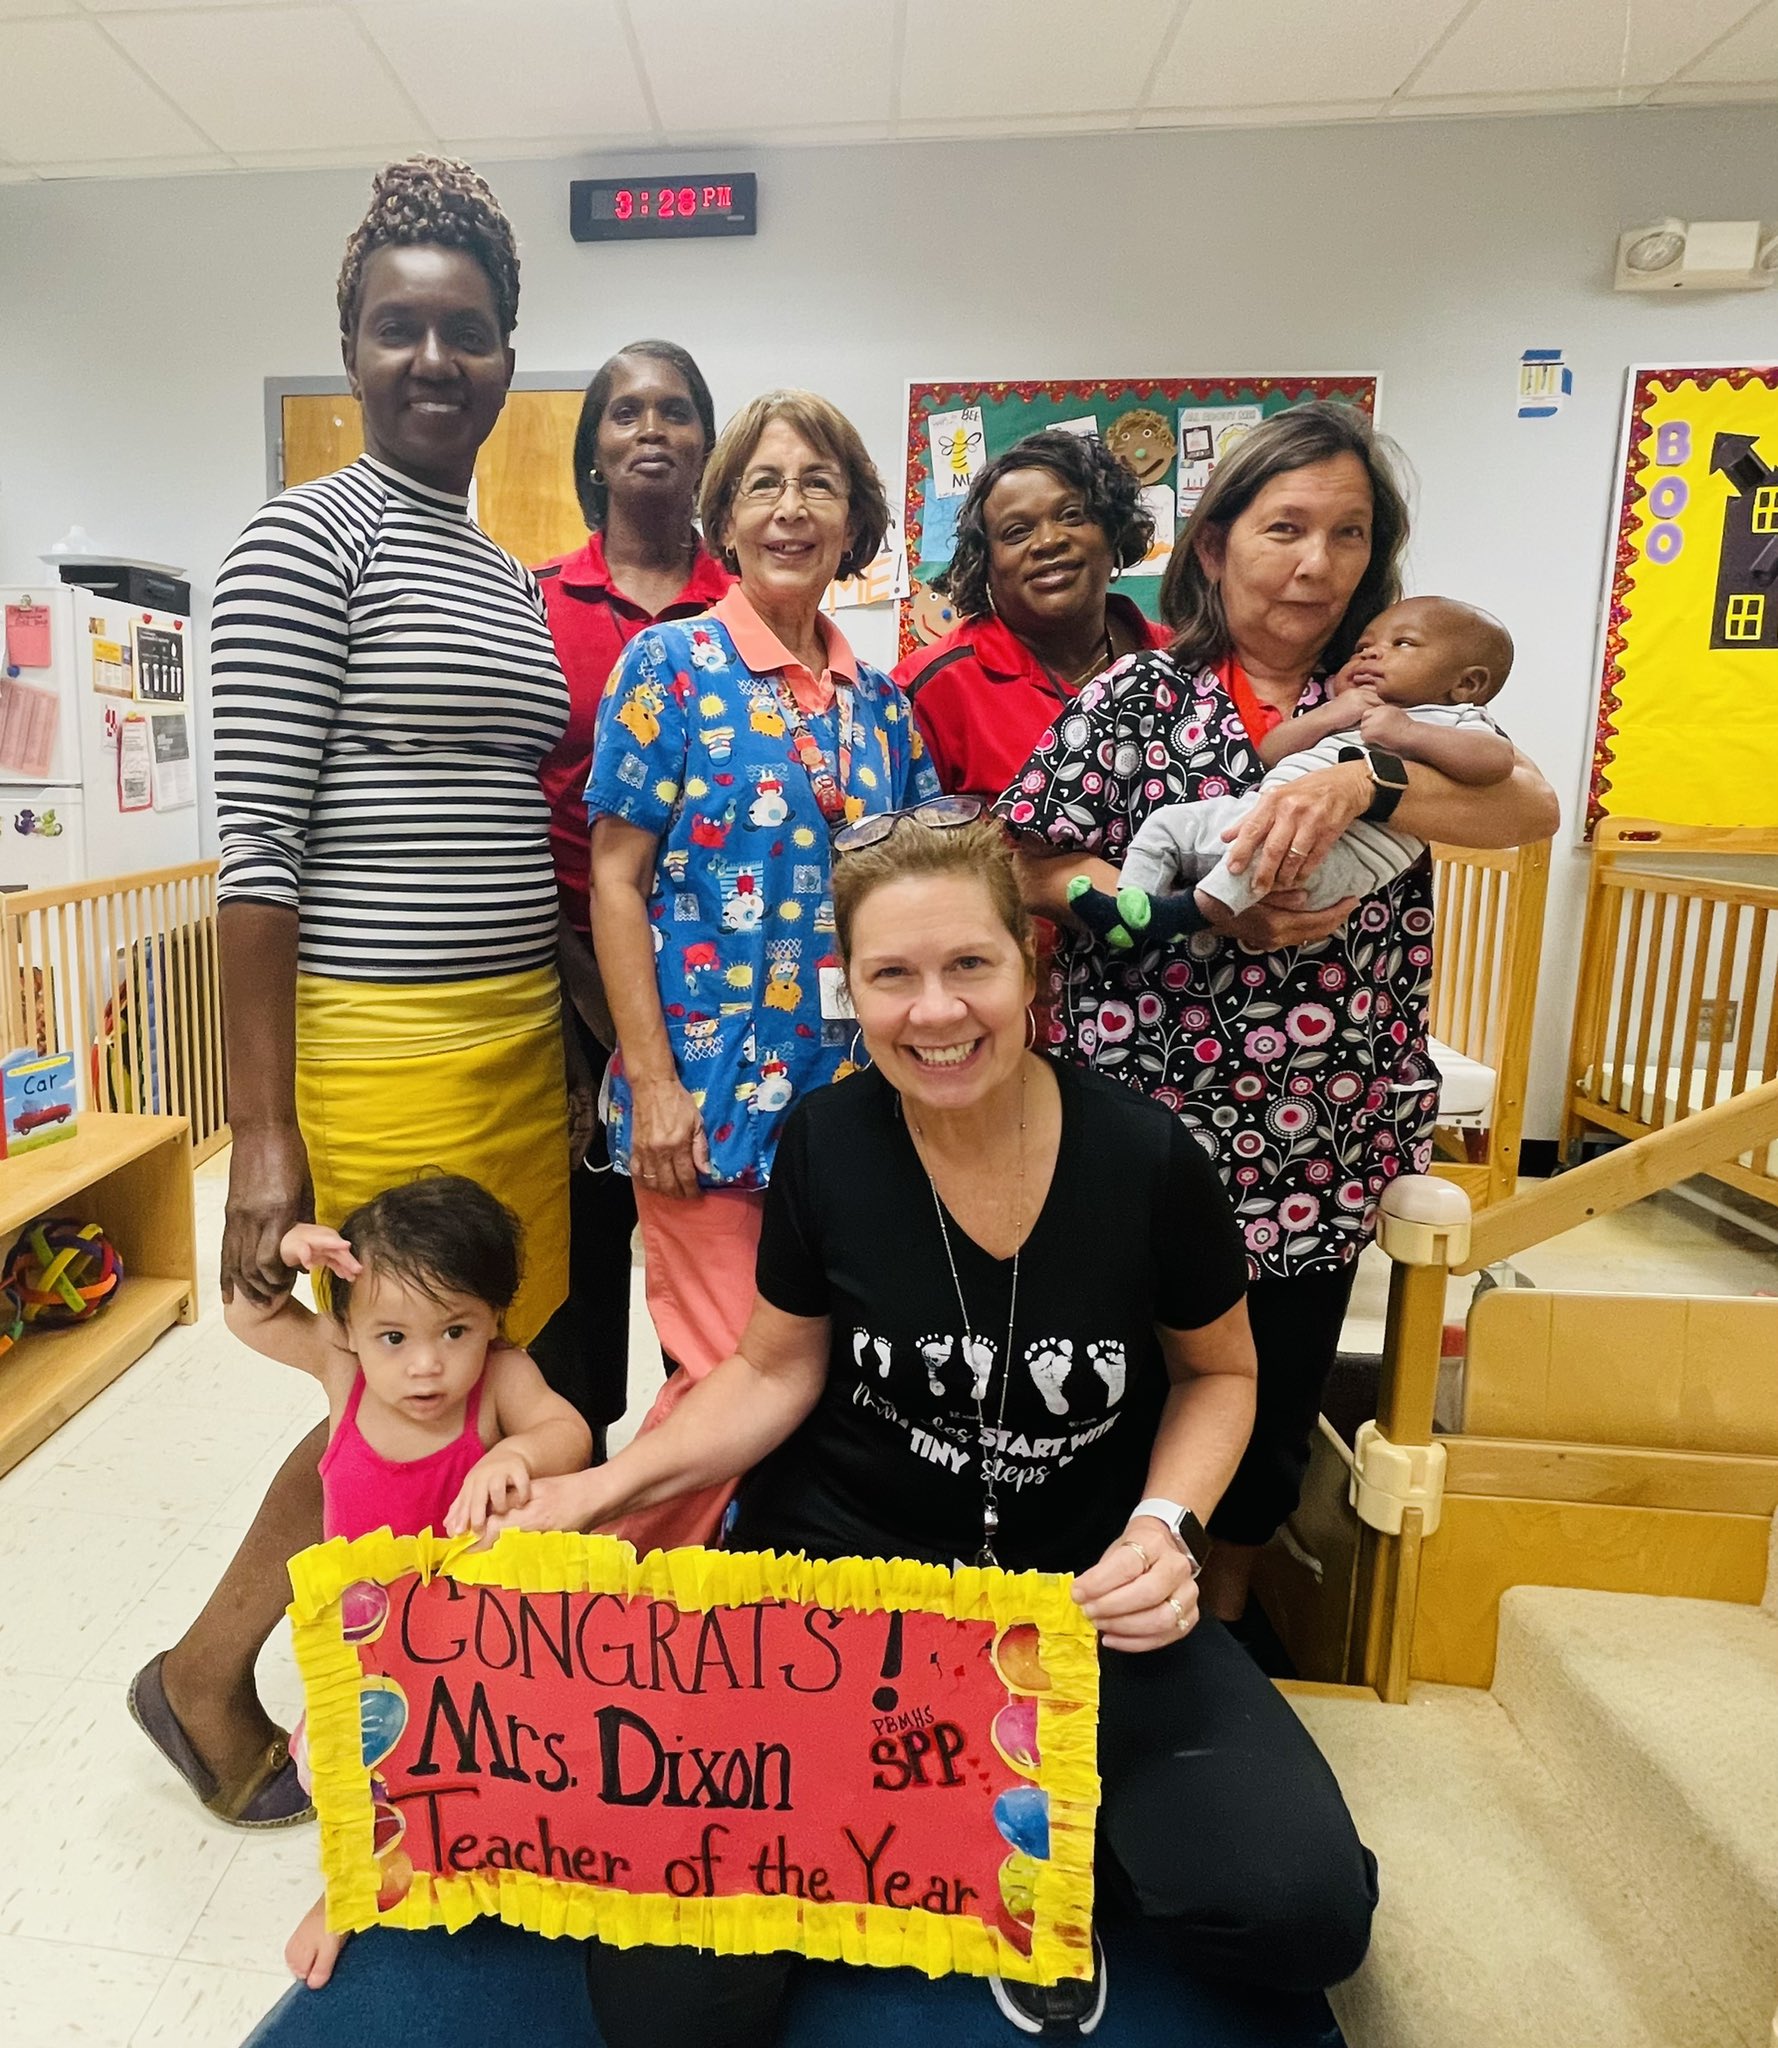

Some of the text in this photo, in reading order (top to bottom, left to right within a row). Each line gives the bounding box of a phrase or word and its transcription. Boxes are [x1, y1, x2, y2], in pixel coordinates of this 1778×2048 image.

[615, 186, 733, 220] 3:28 PM
[1646, 421, 1691, 565] BOO
[23, 1073, 58, 1095] Car
[910, 1427, 971, 1475] TINY
[977, 1427, 1067, 1458] START
[406, 1675, 794, 1811] Mrs. Dixon
[871, 1705, 935, 1737] PBMHS
[871, 1722, 966, 1792] SPP
[385, 1786, 979, 1916] Teacher of the Year
